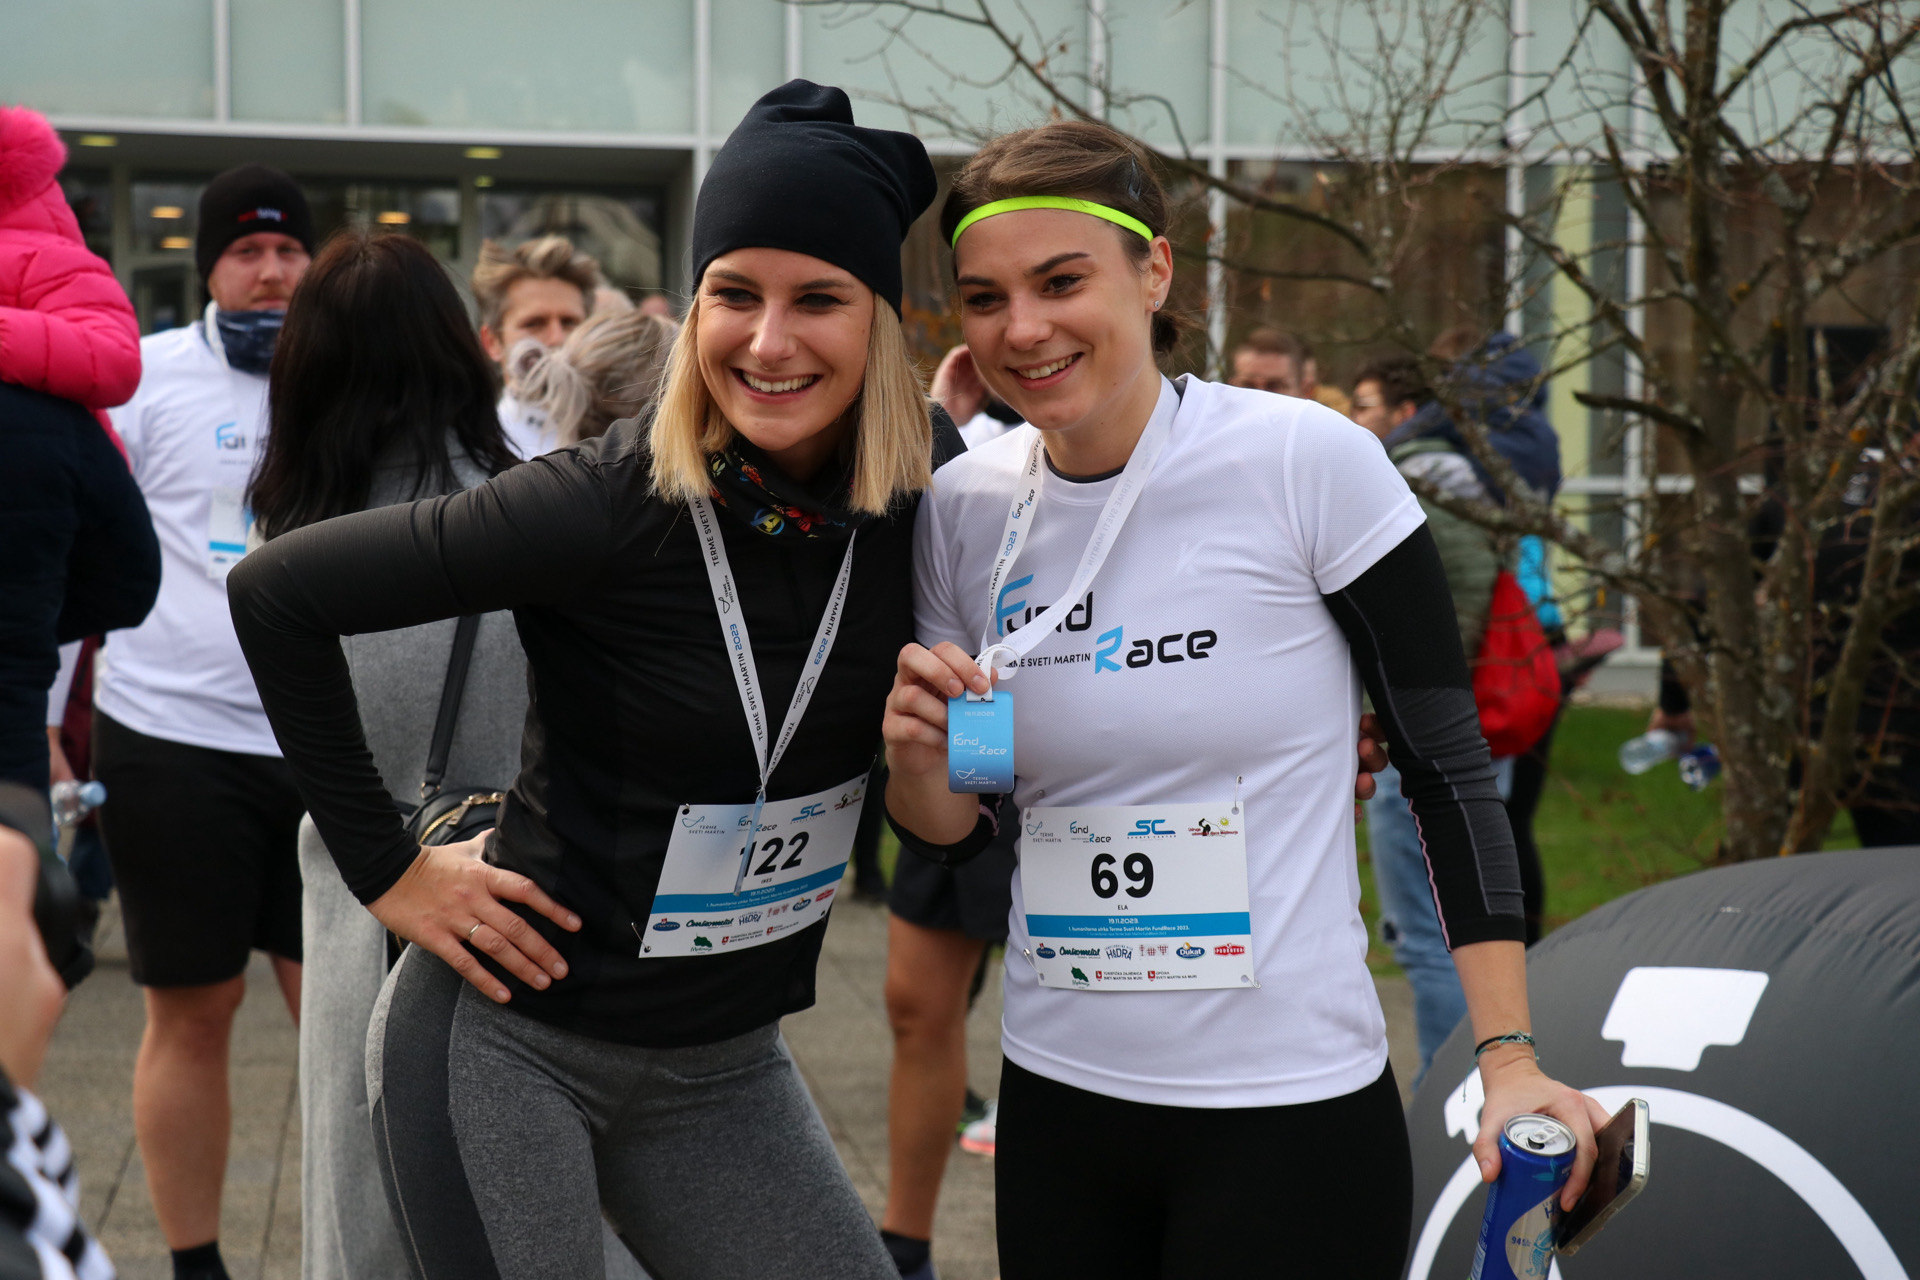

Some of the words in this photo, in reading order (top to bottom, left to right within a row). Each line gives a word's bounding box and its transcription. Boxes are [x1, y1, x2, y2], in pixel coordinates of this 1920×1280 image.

[698, 510, 712, 534] SVETI
[706, 536, 720, 567] TERME
[991, 558, 1006, 590] MARTIN
[1003, 530, 1018, 557] 2023
[836, 577, 848, 600] SVETI
[824, 602, 840, 636] MARTIN
[729, 623, 743, 652] 2023
[1095, 625, 1218, 674] Race
[814, 638, 828, 666] 2023
[1028, 656, 1051, 667] SVETI
[1054, 652, 1091, 666] MARTIN
[736, 652, 751, 685] MARTIN
[746, 688, 758, 711] SVETI
[752, 712, 764, 742] TERME
[779, 722, 795, 750] TERME
[953, 732, 979, 746] Fund
[979, 745, 1007, 756] Race
[738, 815, 752, 827] Fun
[792, 802, 826, 822] SC
[1070, 820, 1089, 834] Fund
[1089, 833, 1112, 843] Race
[1127, 819, 1176, 836] SC
[739, 831, 810, 878] 122
[1091, 852, 1154, 899] 69
